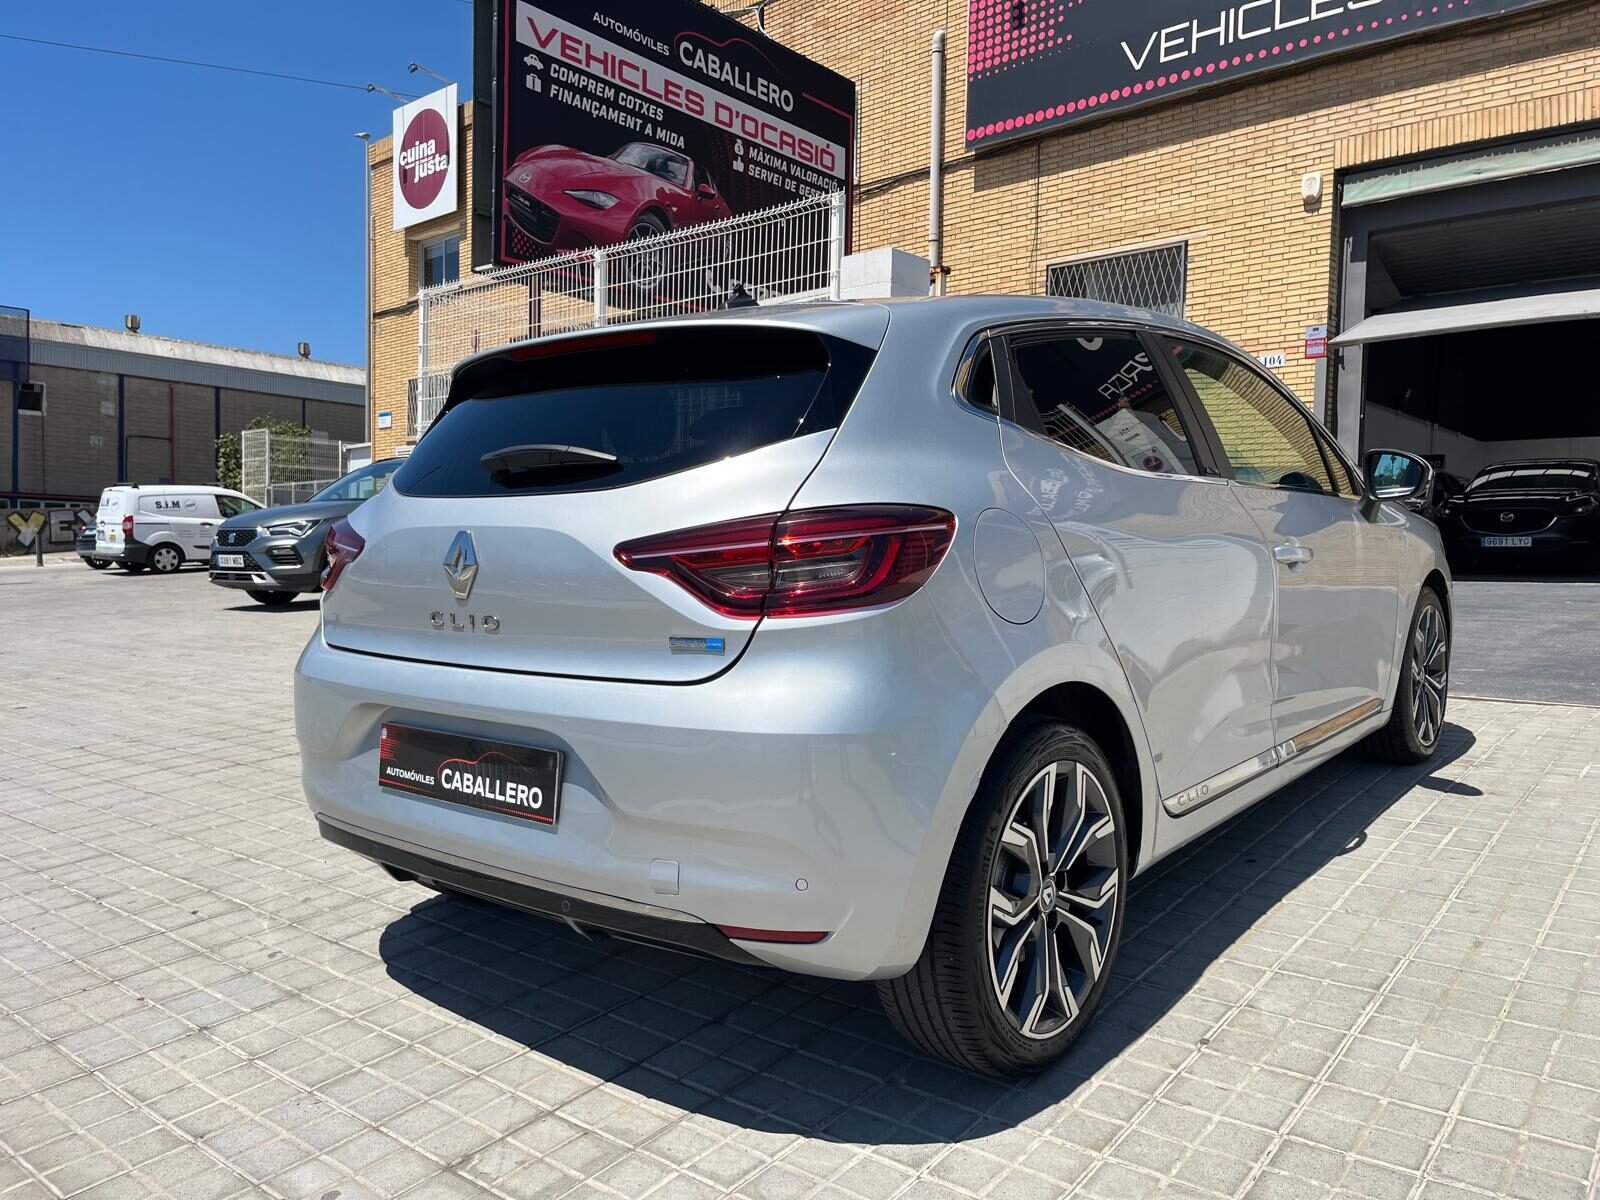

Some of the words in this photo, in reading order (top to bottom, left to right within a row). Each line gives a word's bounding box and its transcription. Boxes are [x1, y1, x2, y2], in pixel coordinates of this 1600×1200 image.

[1120, 0, 1384, 71] VEHICLE
[592, 11, 670, 56] AUTOMÓVILES
[679, 40, 794, 113] CABALLERO
[526, 15, 705, 117] VEHICLES
[714, 100, 836, 172] D'OCASIÓ
[550, 63, 615, 101] COMPREM
[618, 91, 664, 121] COTXES
[550, 84, 643, 132] FINANÇAMENT
[644, 123, 653, 137] A
[656, 126, 686, 149] MIDA
[399, 138, 436, 166] cuina
[413, 152, 449, 183] justa
[749, 147, 788, 173] MÀXIMA
[790, 163, 838, 192] VALORACIÓ
[748, 164, 782, 187] SERVEI
[784, 178, 797, 192] DE
[1264, 355, 1283, 366] 104
[429, 610, 501, 632] CLIO
[386, 766, 435, 785] AUTOMÓVILES
[441, 768, 543, 809] CABALLERO
[1177, 784, 1210, 807] CLIO
